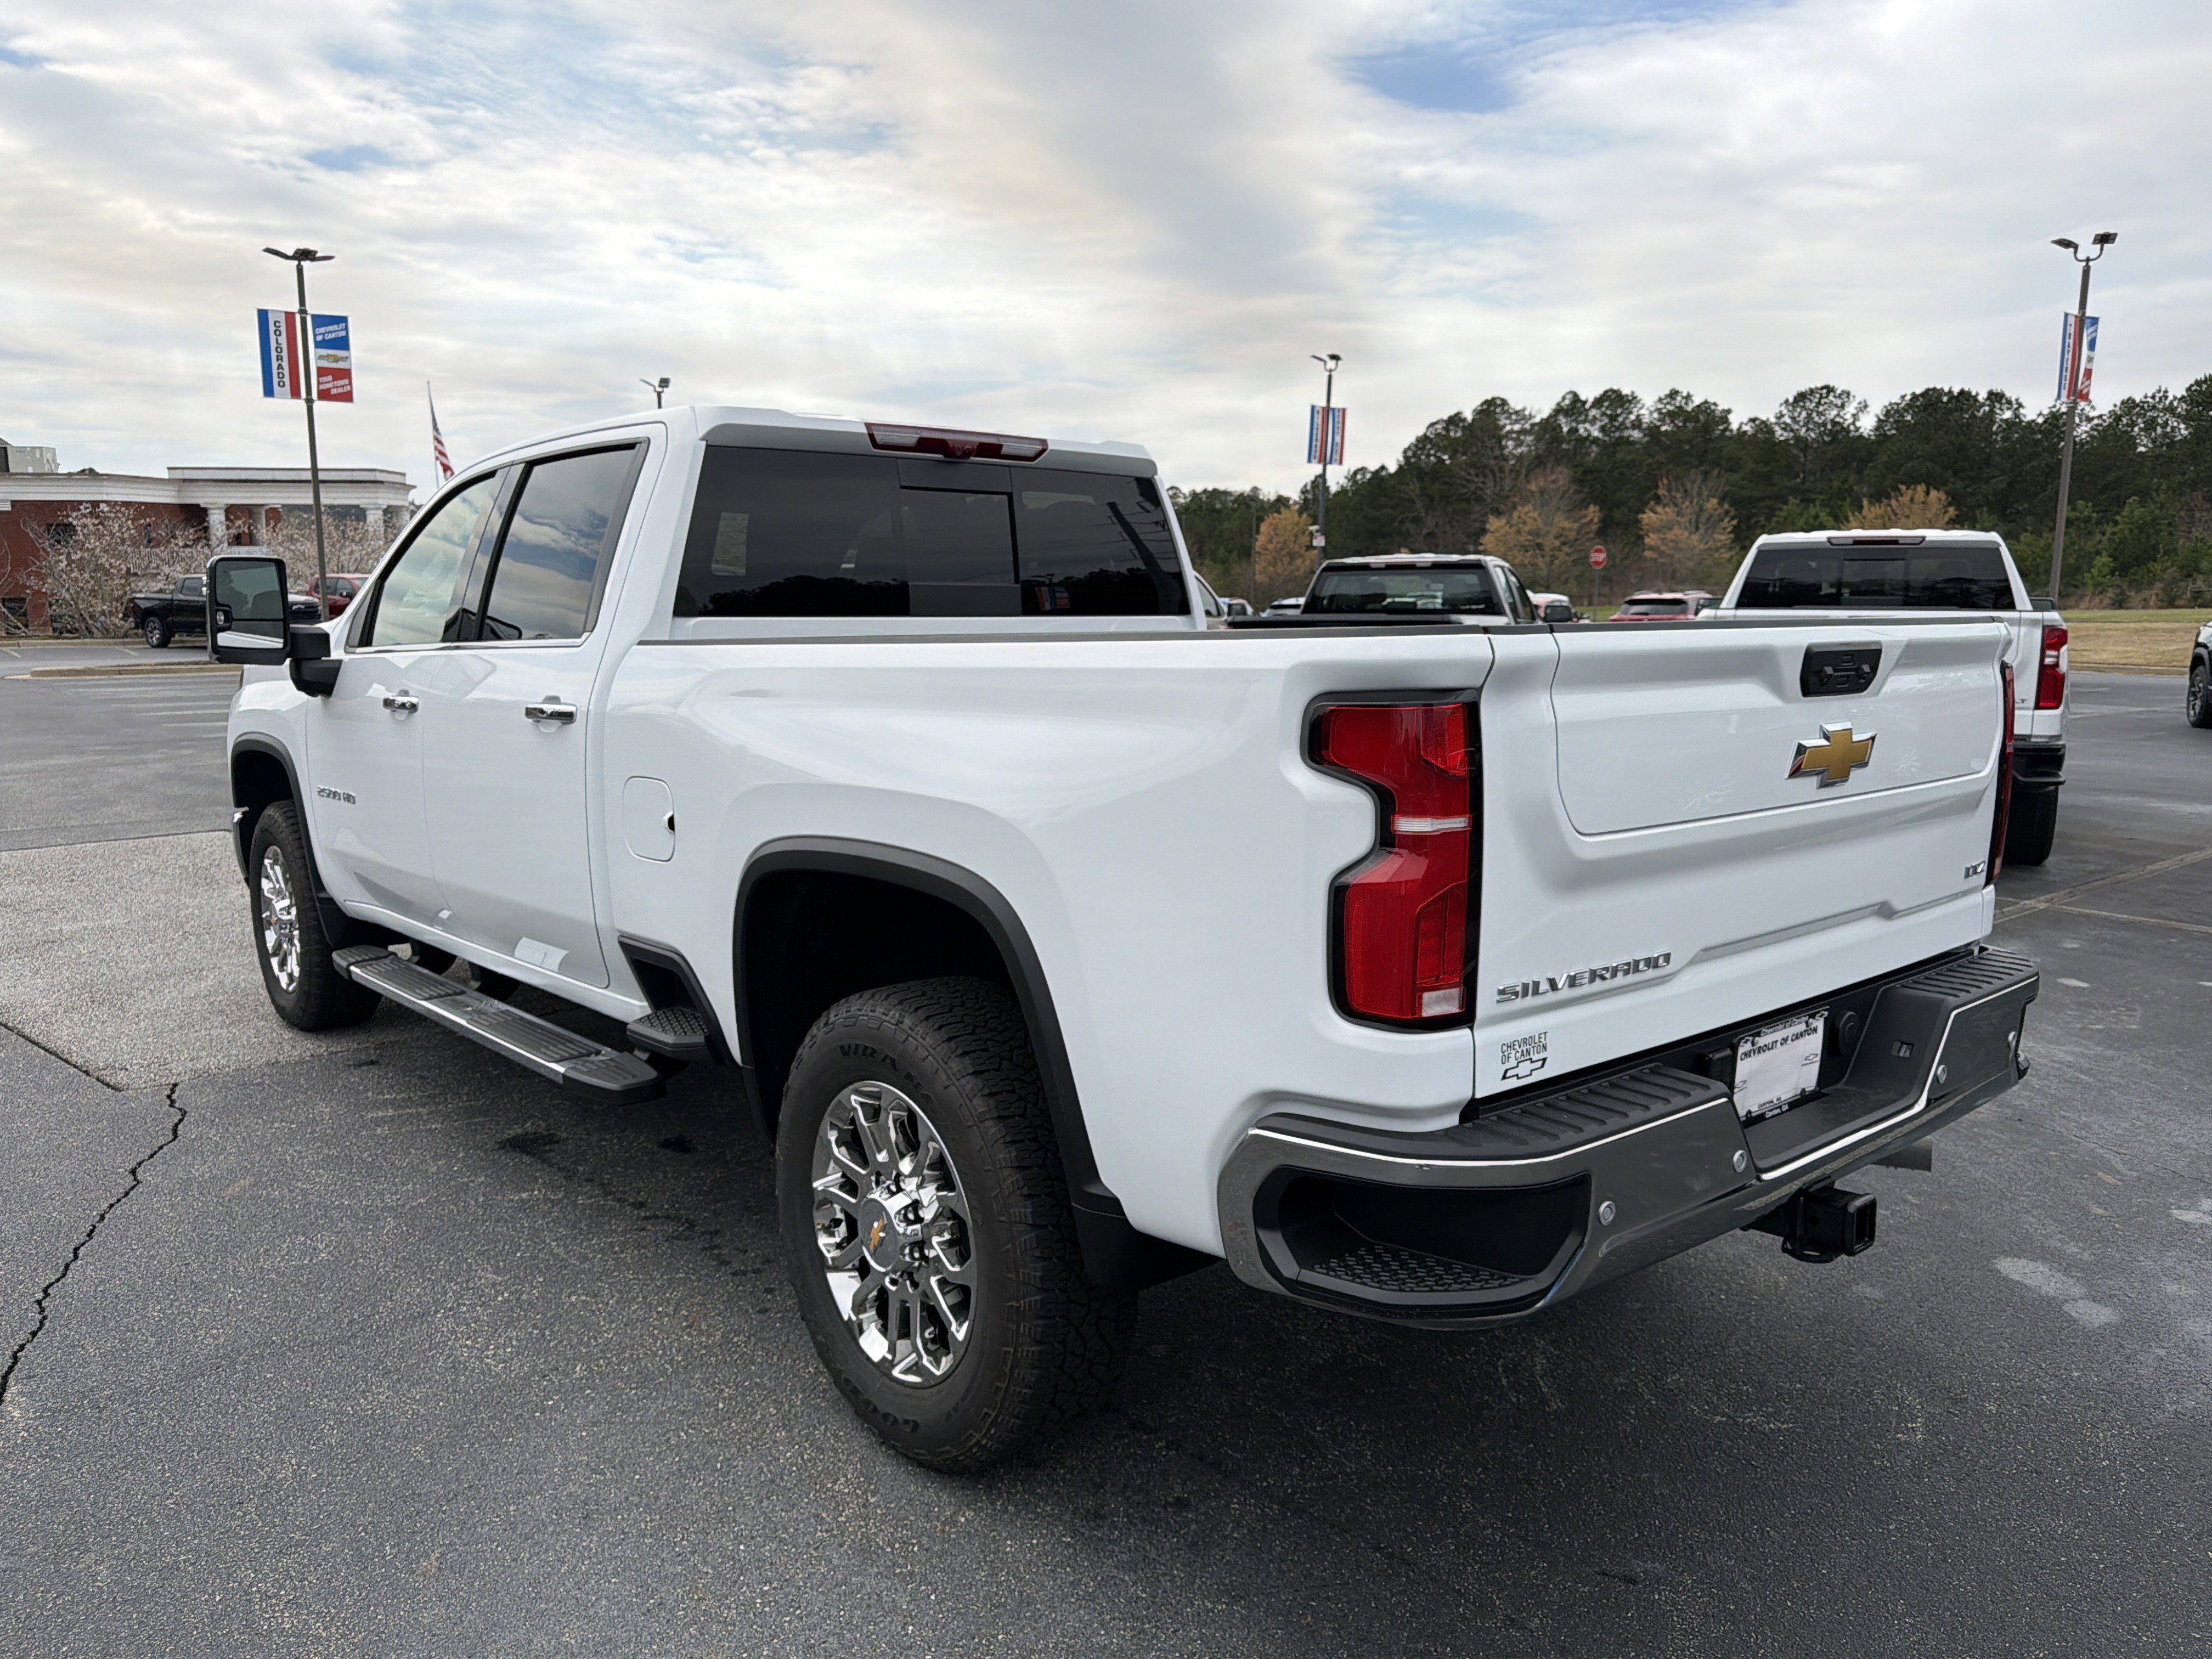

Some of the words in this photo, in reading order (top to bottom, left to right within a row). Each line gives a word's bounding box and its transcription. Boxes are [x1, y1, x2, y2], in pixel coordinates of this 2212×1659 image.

[315, 323, 346, 335] CHEVROLET
[316, 333, 323, 342] OF
[273, 320, 286, 388] COLORADO
[1496, 951, 1672, 1003] SILVERADO
[1500, 1031, 1548, 1054] CHEVROLET
[1500, 1052, 1512, 1065] OF
[1514, 1042, 1547, 1060] CANTON
[1740, 1039, 1779, 1061] CHEVROLET
[1780, 1035, 1790, 1046] OF
[1791, 1025, 1818, 1042] CANTON
